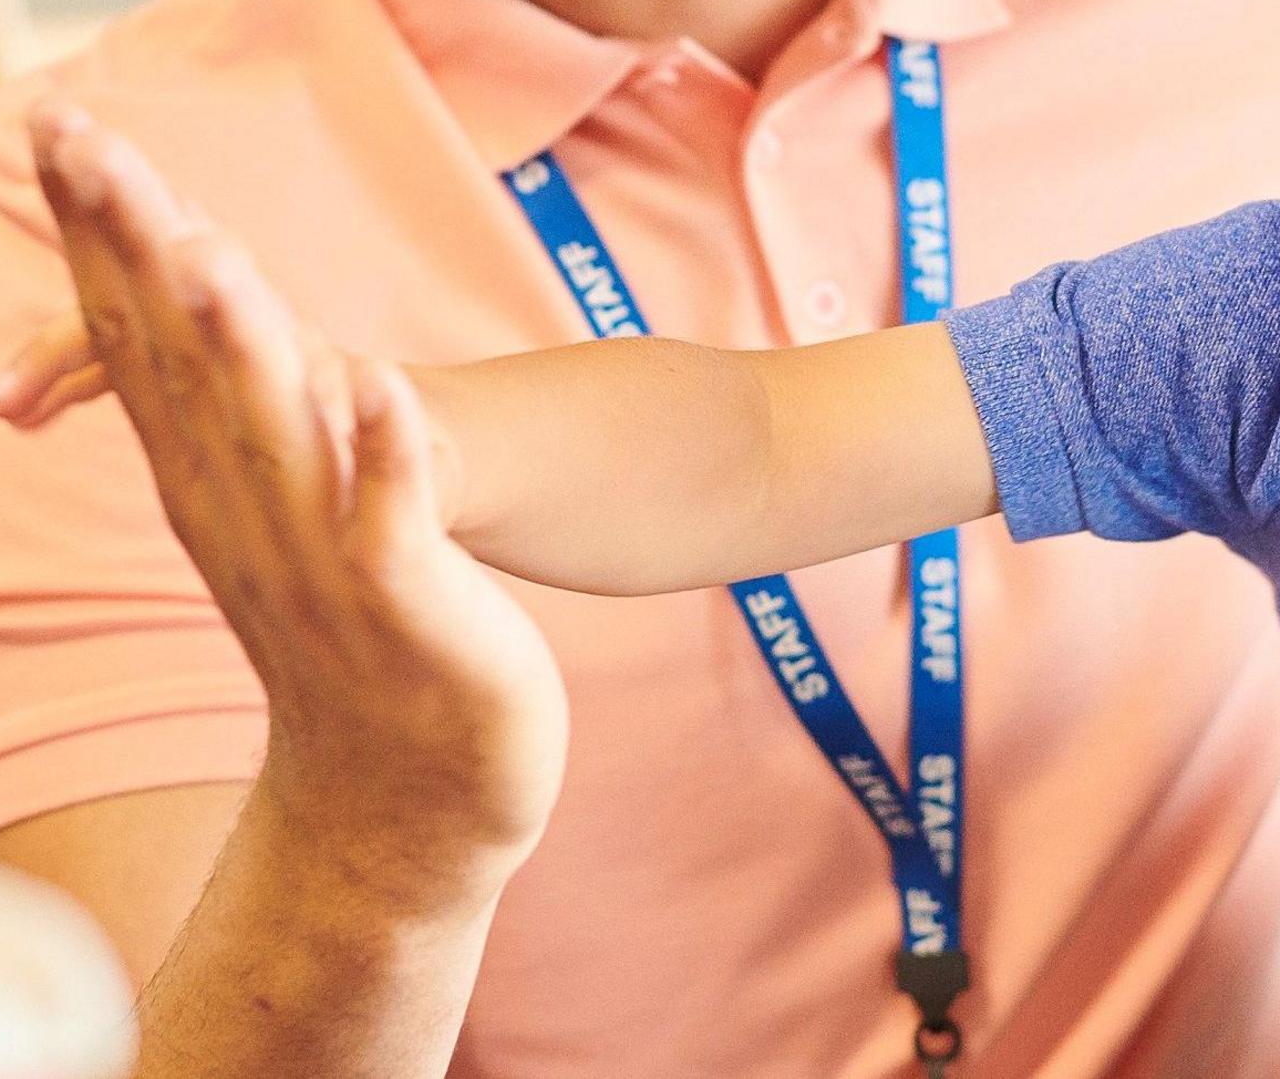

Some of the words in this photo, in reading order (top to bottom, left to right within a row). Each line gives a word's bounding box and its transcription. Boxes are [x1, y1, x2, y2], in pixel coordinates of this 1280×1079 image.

[906, 179, 946, 302] STAFF
[745, 590, 829, 702] STAFF
[921, 557, 956, 682] STAFF
